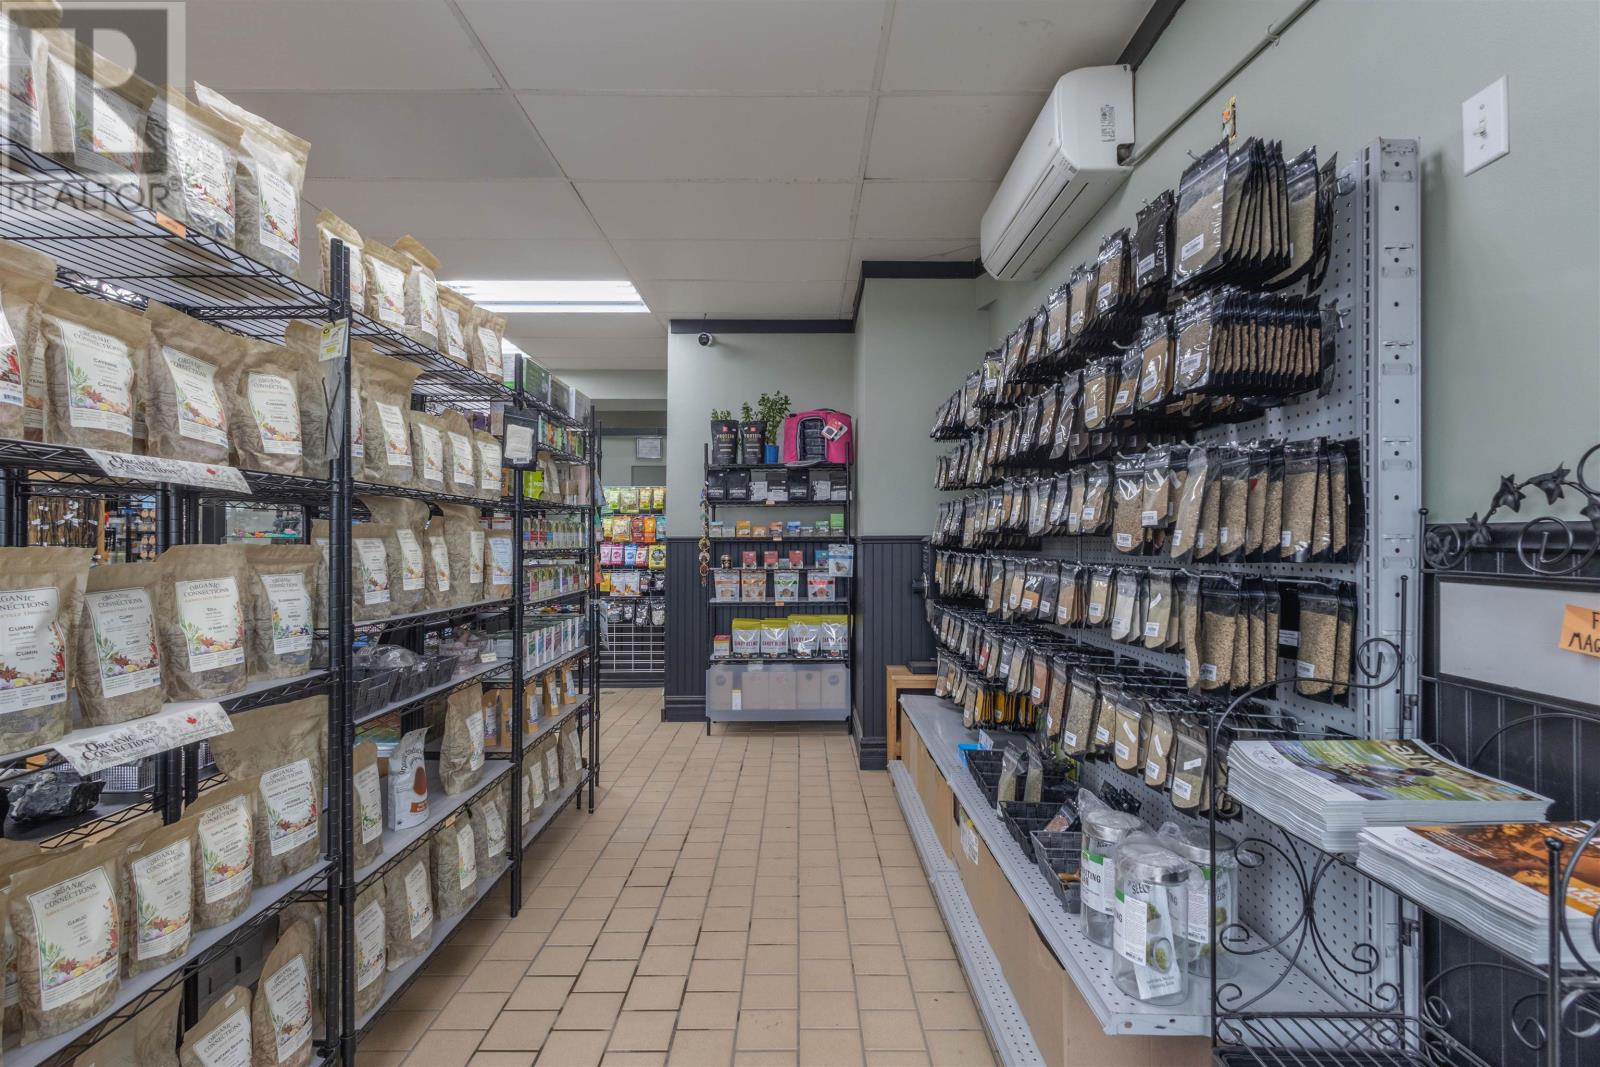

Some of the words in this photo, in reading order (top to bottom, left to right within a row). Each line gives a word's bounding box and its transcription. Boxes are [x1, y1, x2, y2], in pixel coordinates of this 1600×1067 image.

[188, 581, 220, 592] ORGANIC
[182, 588, 230, 599] CONNECTIONS
[97, 598, 144, 609] CONNECTIONS
[8, 625, 35, 633] CUMIN
[81, 736, 158, 762] CONNECTIONS
[84, 733, 135, 752] ORGANIC
[53, 879, 87, 899] ORGANIC
[44, 883, 98, 911] CONNECTIONS
[67, 914, 88, 927] GARLIC
